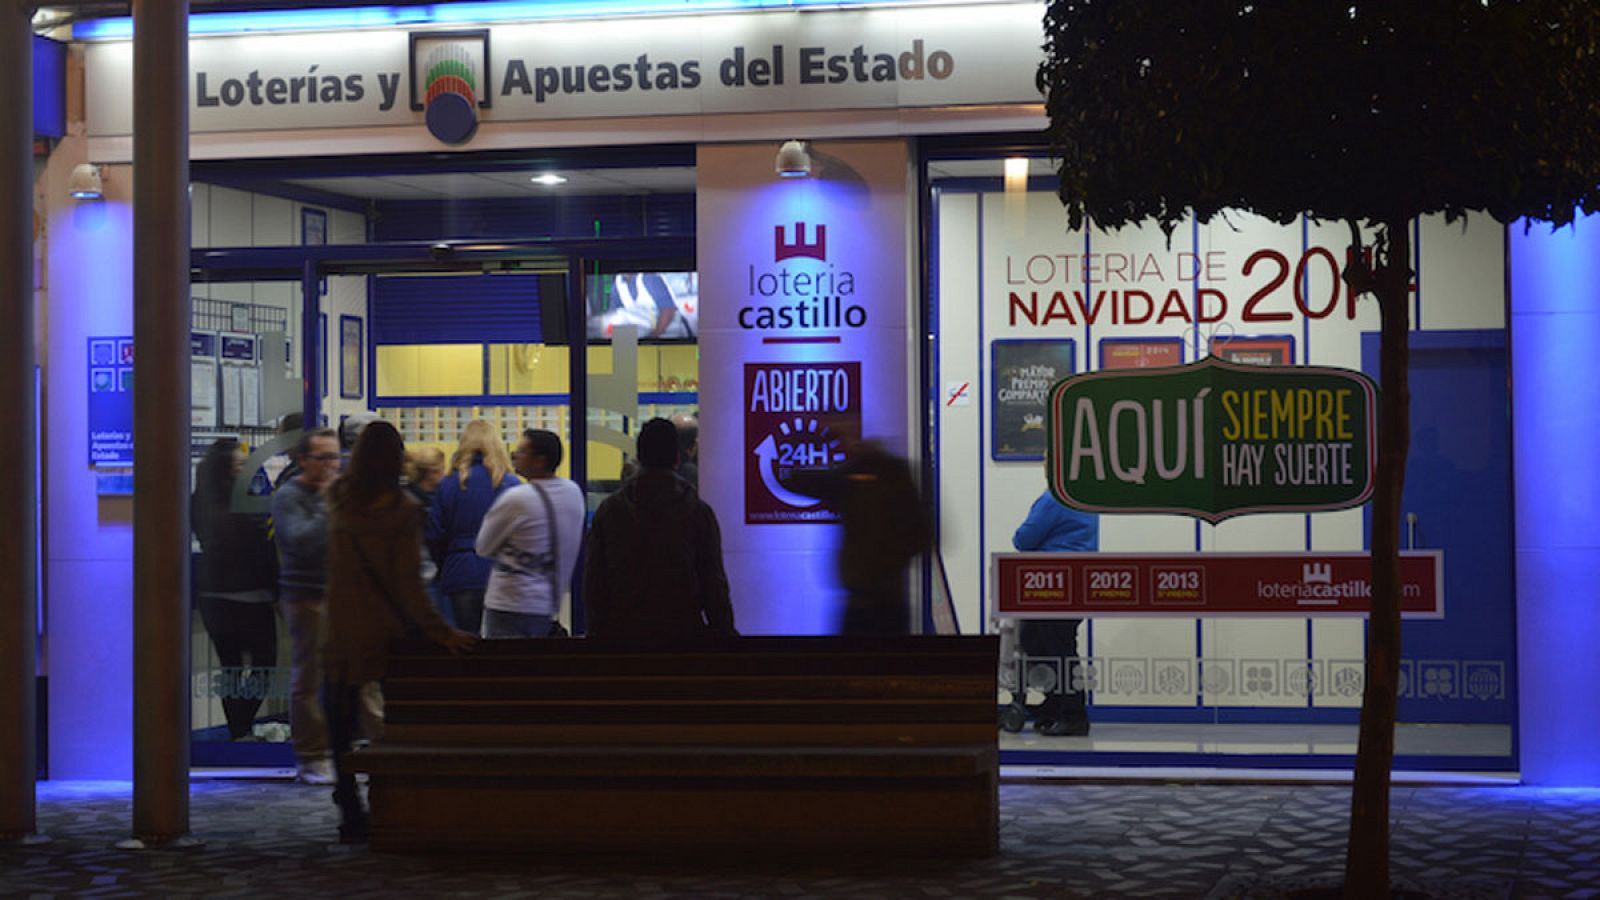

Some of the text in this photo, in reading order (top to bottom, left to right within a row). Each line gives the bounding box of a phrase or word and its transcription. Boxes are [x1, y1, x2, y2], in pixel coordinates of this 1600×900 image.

[197, 39, 955, 111] Loterías y Apuestas del Estado
[749, 264, 855, 297] loteria
[1007, 251, 1227, 285] LOTERIA DE
[1241, 246, 1417, 321] 201
[738, 296, 868, 330] castillo
[1008, 288, 1229, 326] NAVIDAD
[751, 367, 849, 413] ABIERTO
[1221, 388, 1354, 442] SIEMPRE
[1068, 386, 1212, 485] AQUÍ
[779, 443, 830, 466] 24H
[1222, 442, 1353, 486] HAY SUERTE
[1023, 571, 1065, 589] 2011
[1090, 571, 1132, 589] 2012
[1157, 571, 1199, 589] 2013
